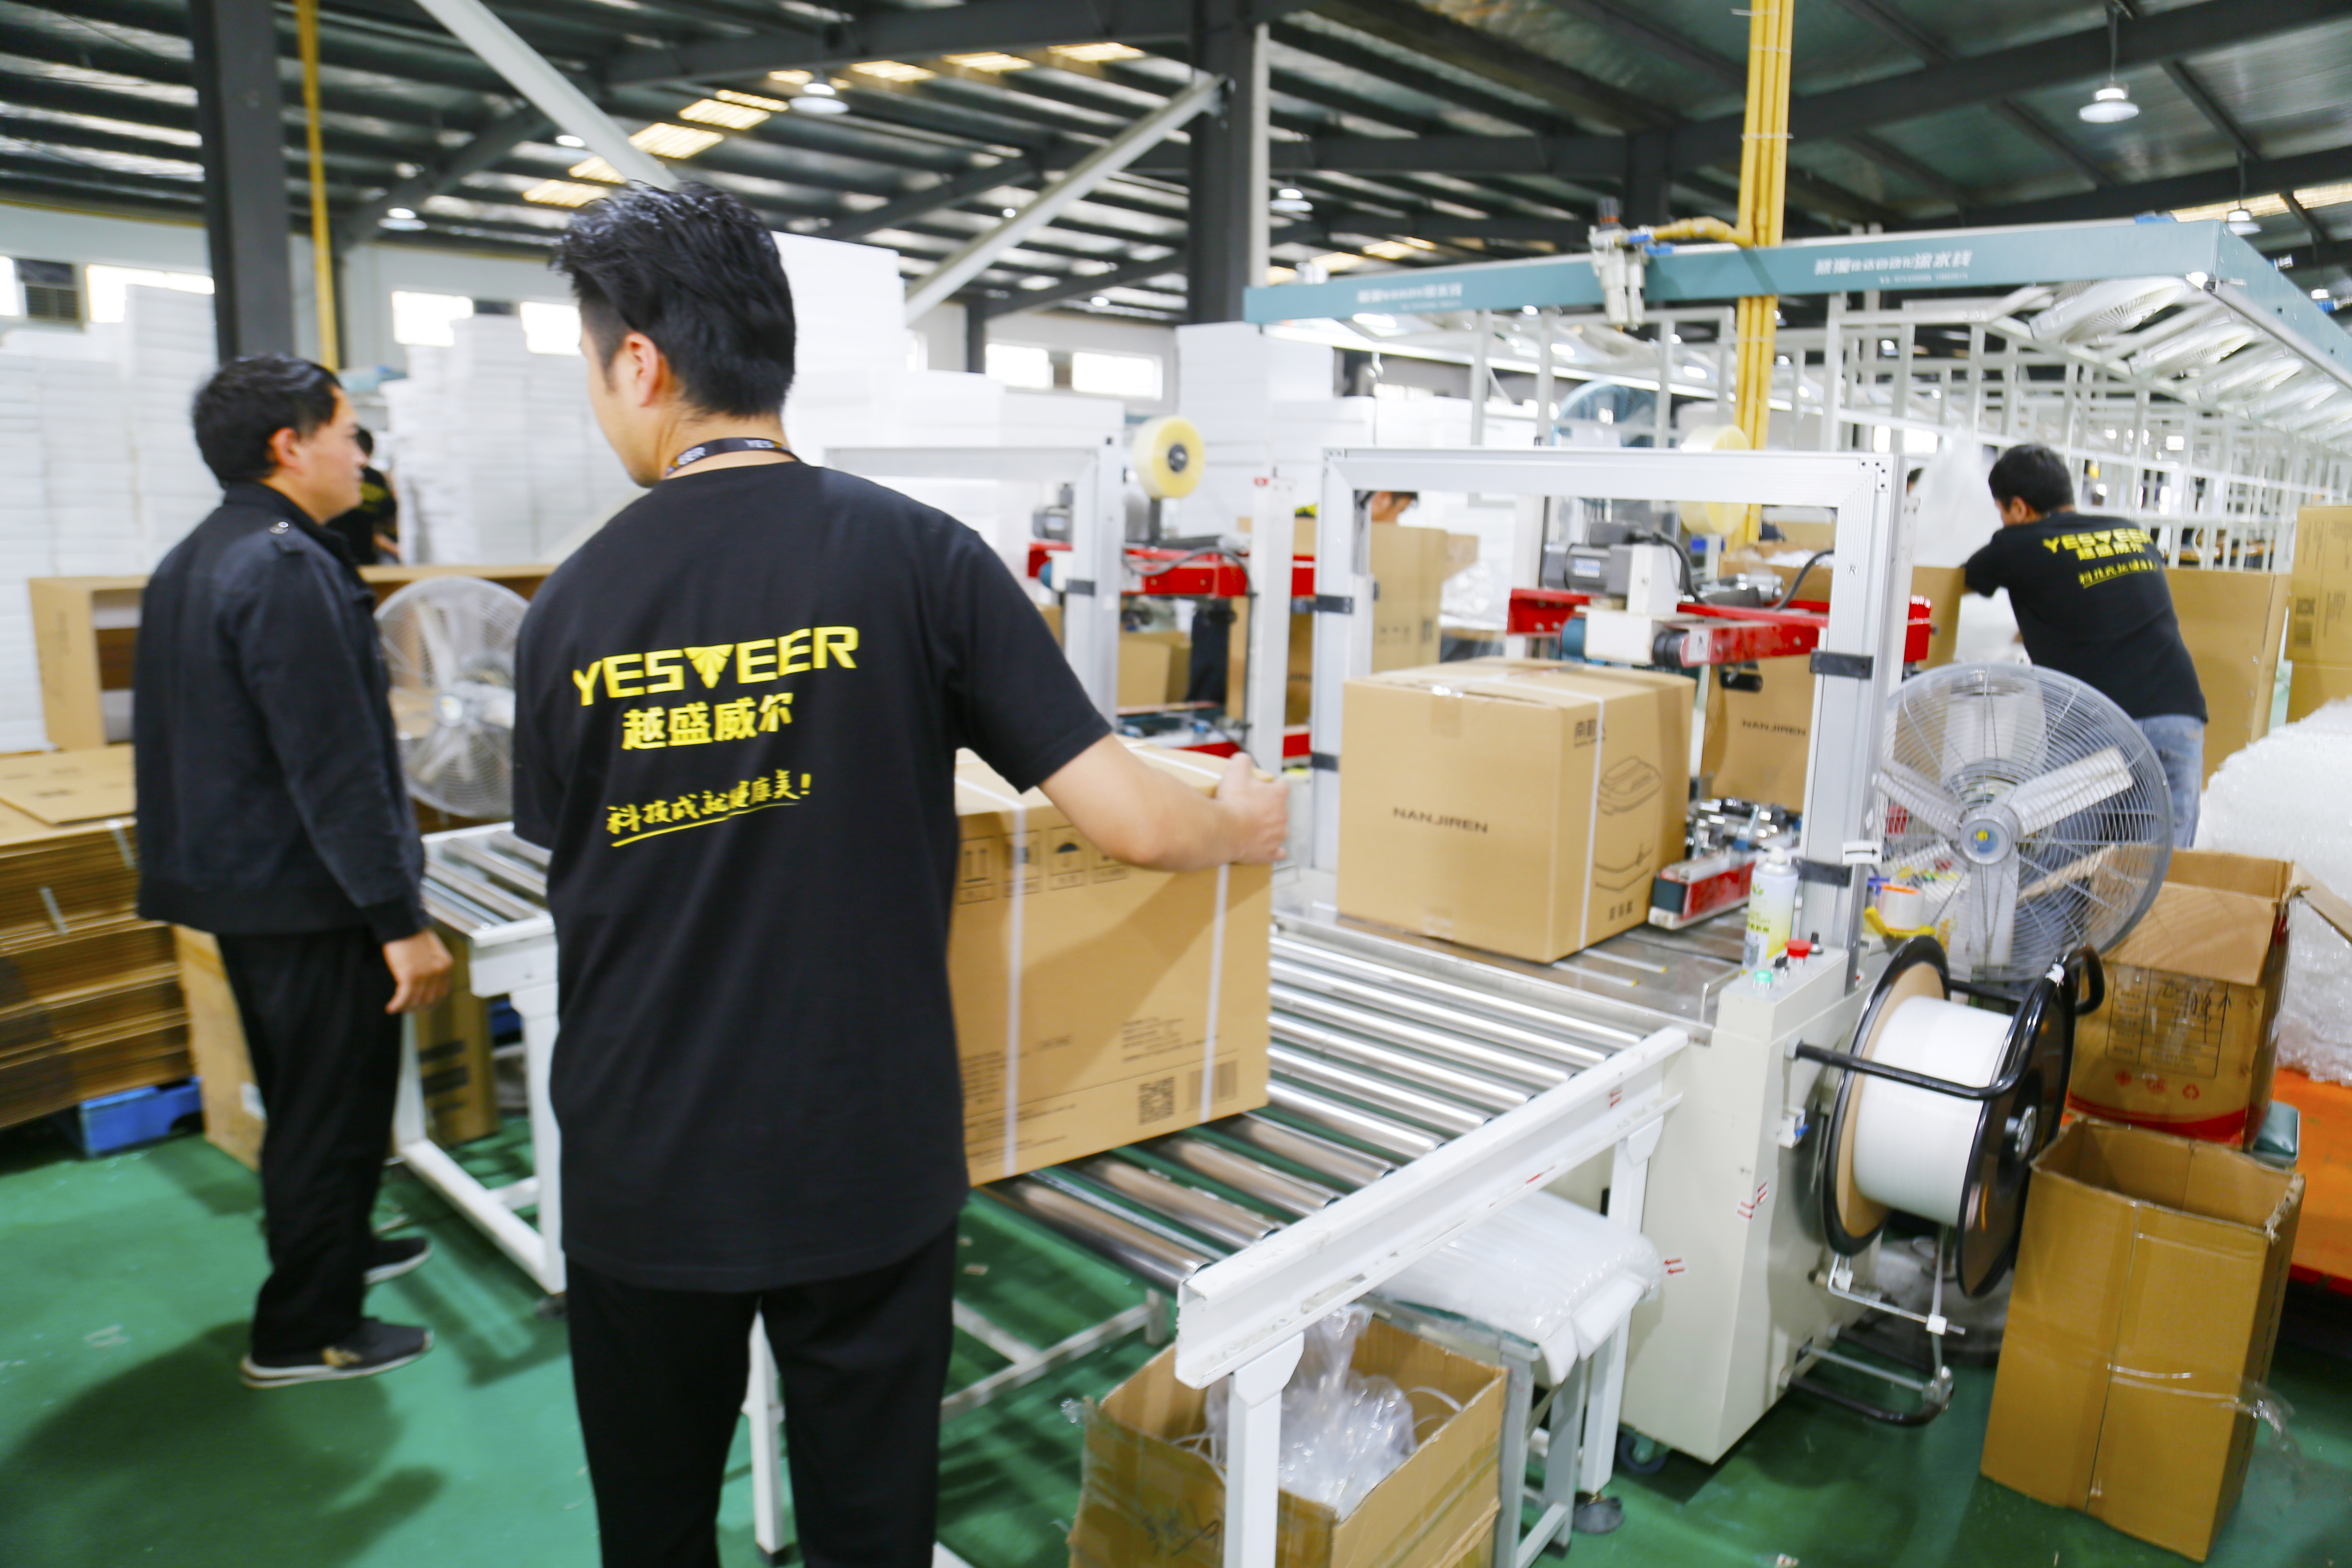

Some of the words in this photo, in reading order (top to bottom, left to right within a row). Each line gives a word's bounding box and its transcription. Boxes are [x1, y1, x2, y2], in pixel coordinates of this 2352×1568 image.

[622, 692, 793, 750] 越盛威尔
[1393, 807, 1488, 834] NANJIREN
